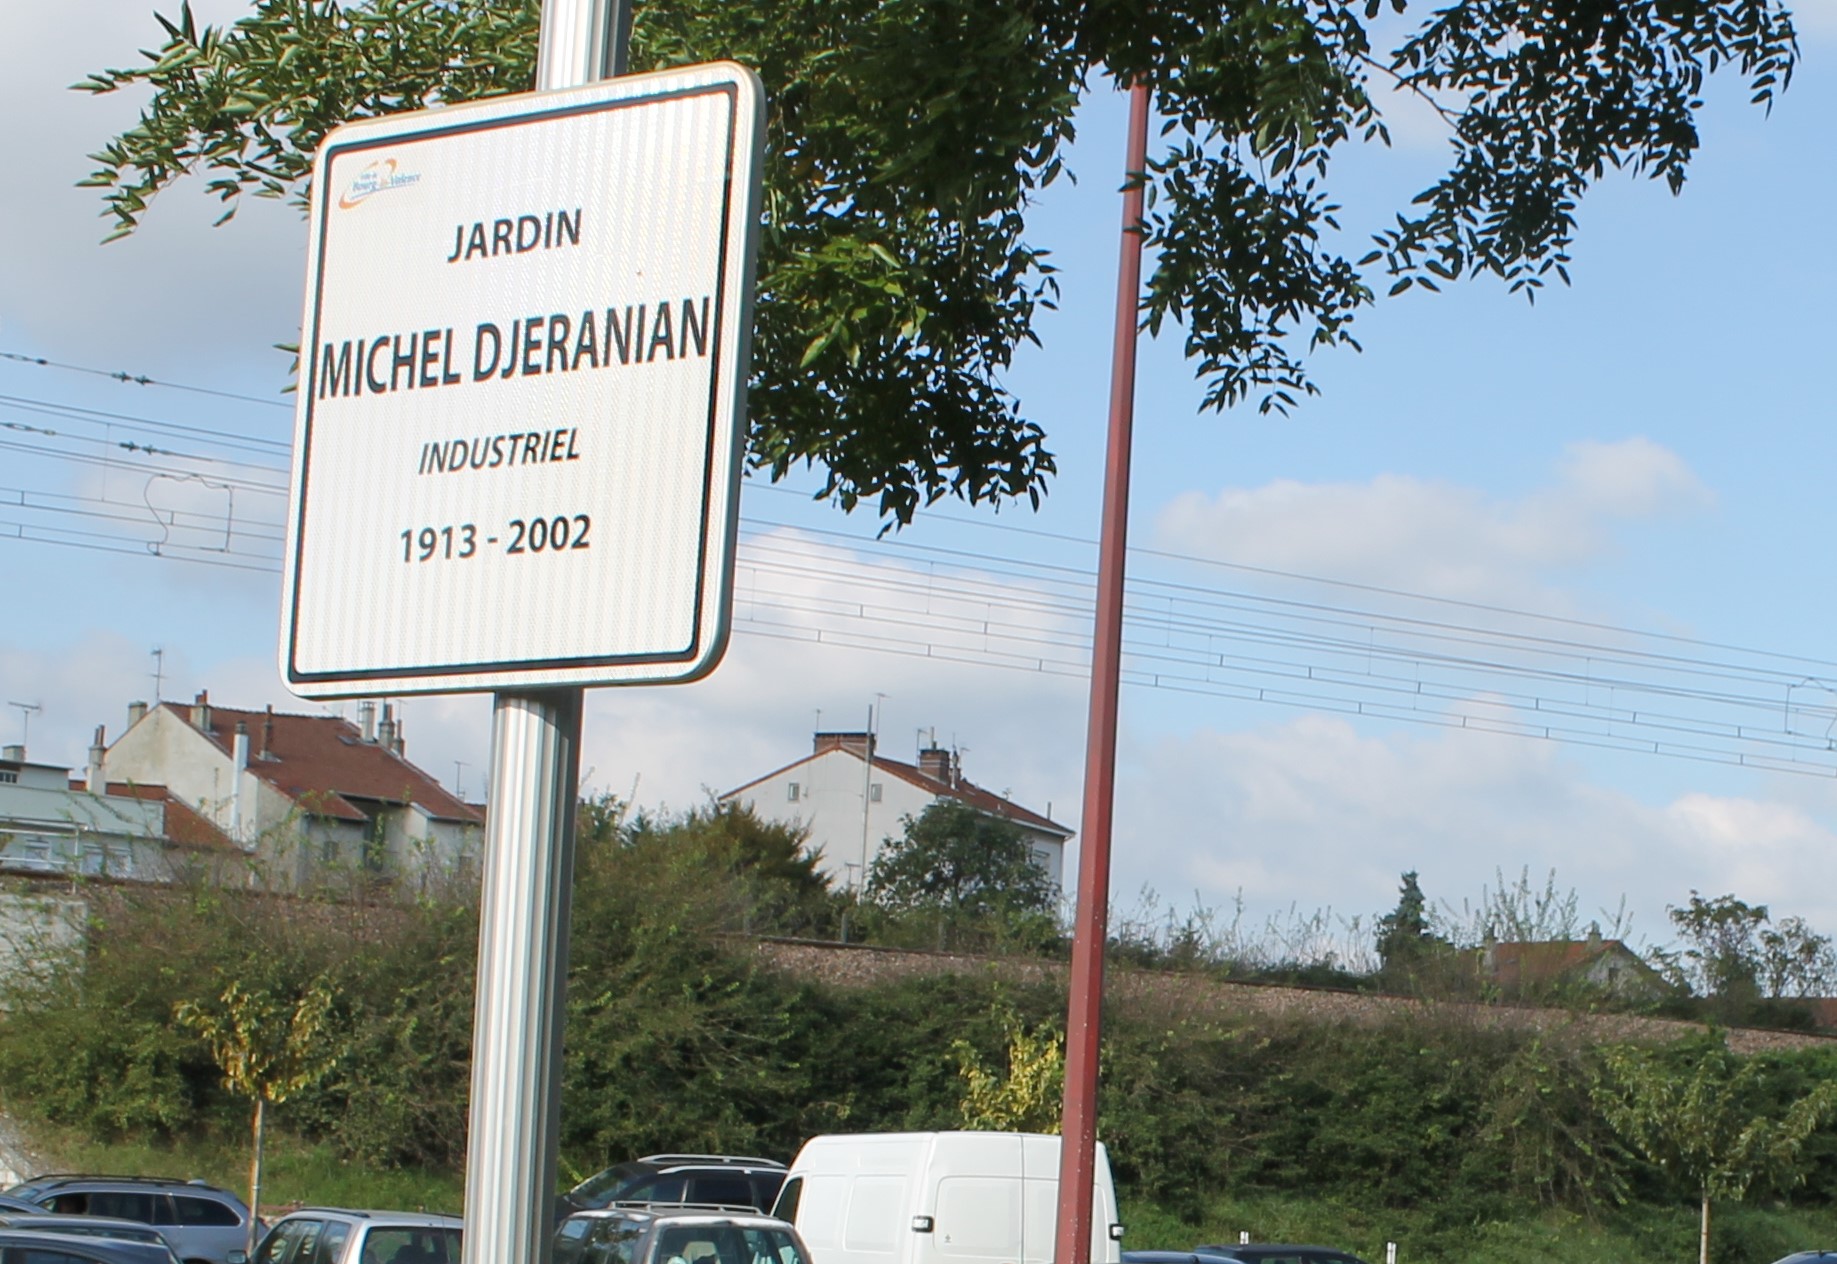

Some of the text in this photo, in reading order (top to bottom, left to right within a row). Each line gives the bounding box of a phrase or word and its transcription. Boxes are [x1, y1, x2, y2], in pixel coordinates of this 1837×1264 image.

[447, 207, 582, 264] JARDIN
[318, 295, 711, 400] MICHEL DJERANIAN
[418, 426, 581, 476] INDUSTRIEL
[400, 522, 478, 563] 1913
[506, 513, 592, 555] 2002
